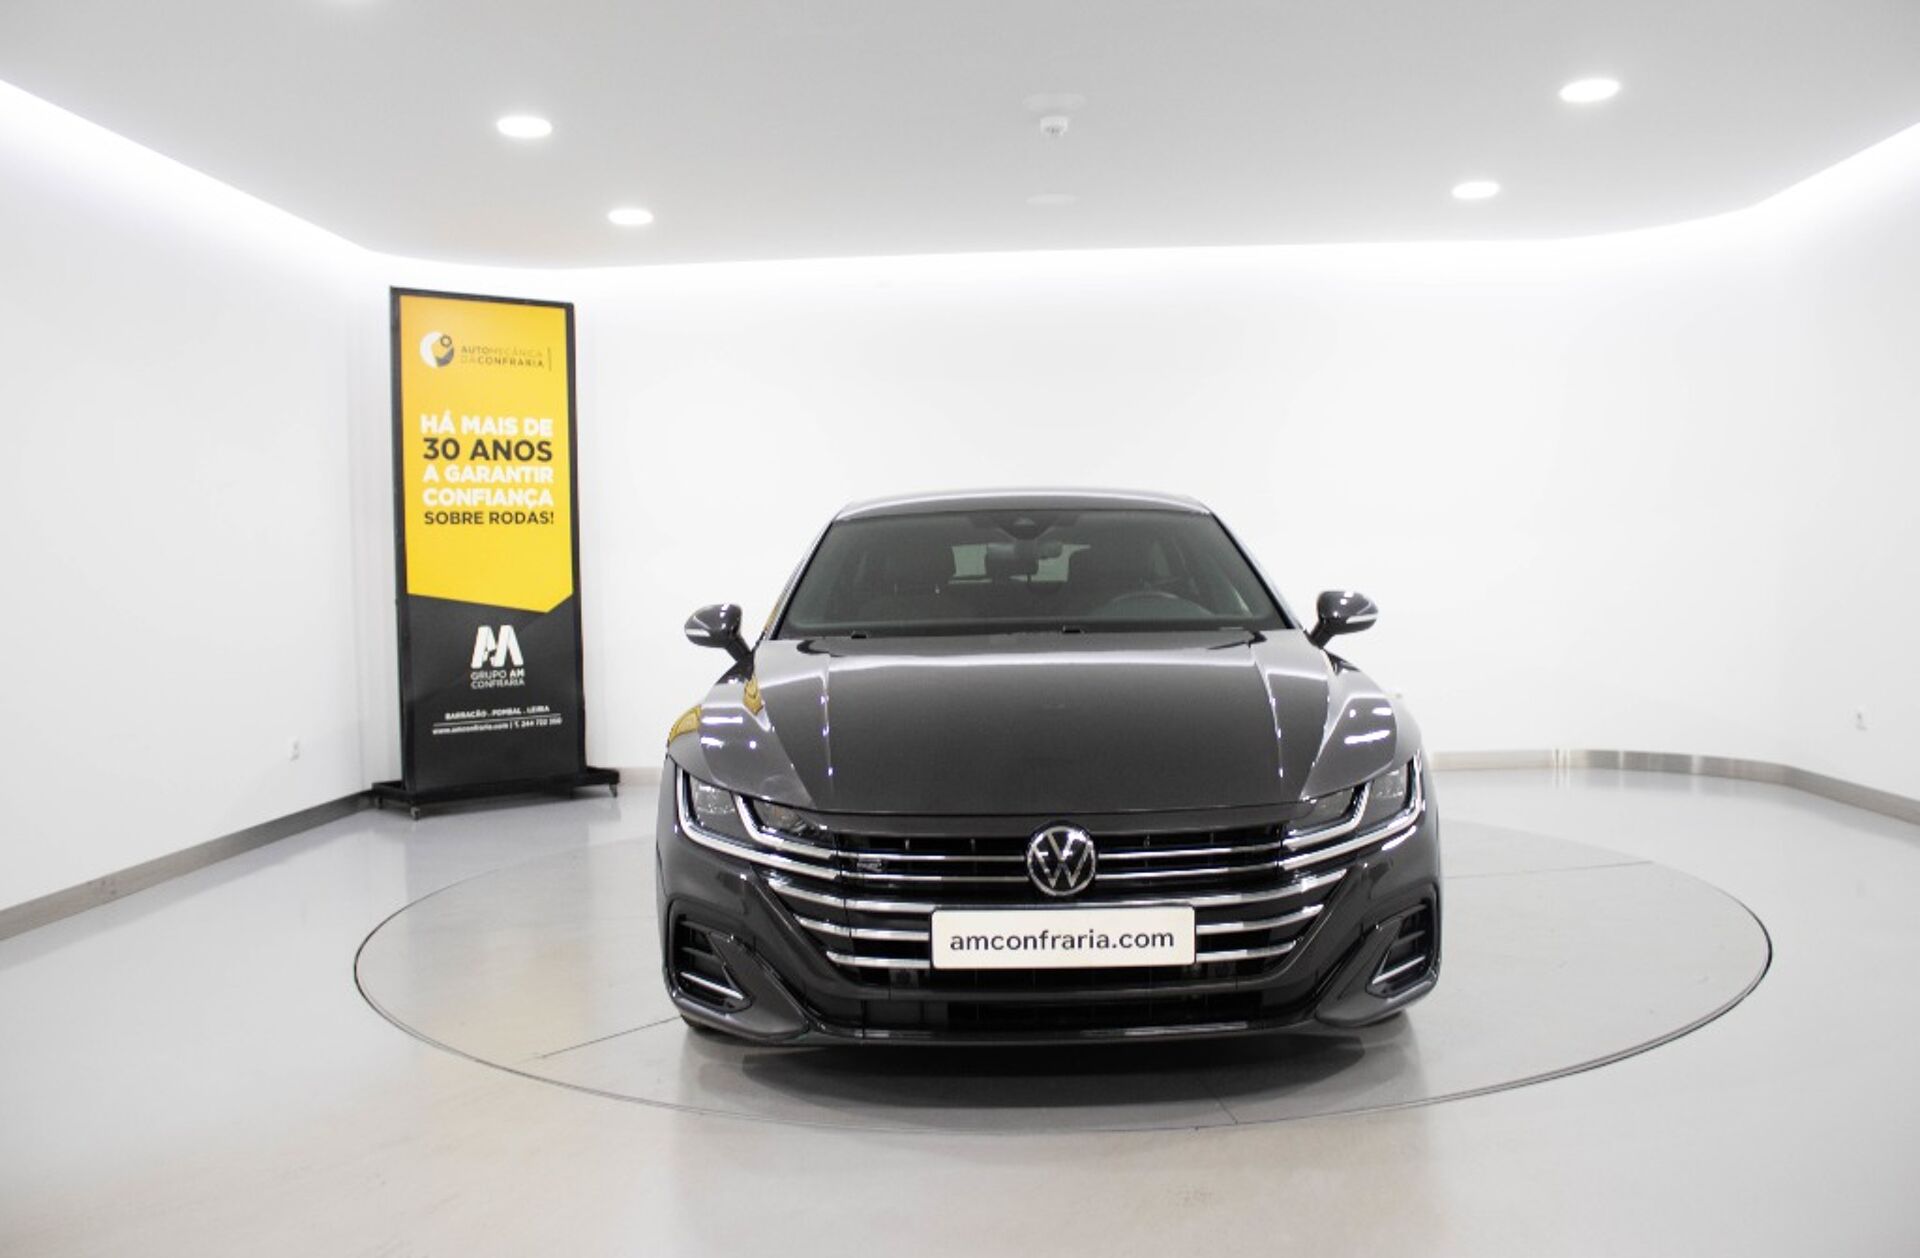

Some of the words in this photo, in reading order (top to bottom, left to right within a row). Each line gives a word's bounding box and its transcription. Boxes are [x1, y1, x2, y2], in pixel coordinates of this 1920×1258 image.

[420, 410, 455, 434] HÁ
[461, 415, 517, 435] MAIS
[524, 418, 553, 437] DE
[423, 438, 460, 460] 30
[470, 439, 553, 462] ANOS
[423, 464, 439, 483] A
[444, 465, 553, 483] GARANTIR
[422, 488, 554, 509] CONFIANÇA
[424, 511, 484, 524] SOBRE
[489, 511, 555, 525] RODAS!
[471, 670, 507, 680] GRUPO
[510, 668, 525, 678] AM
[471, 678, 526, 689] CONFRARIA
[949, 929, 1175, 953] amconfraria.com
